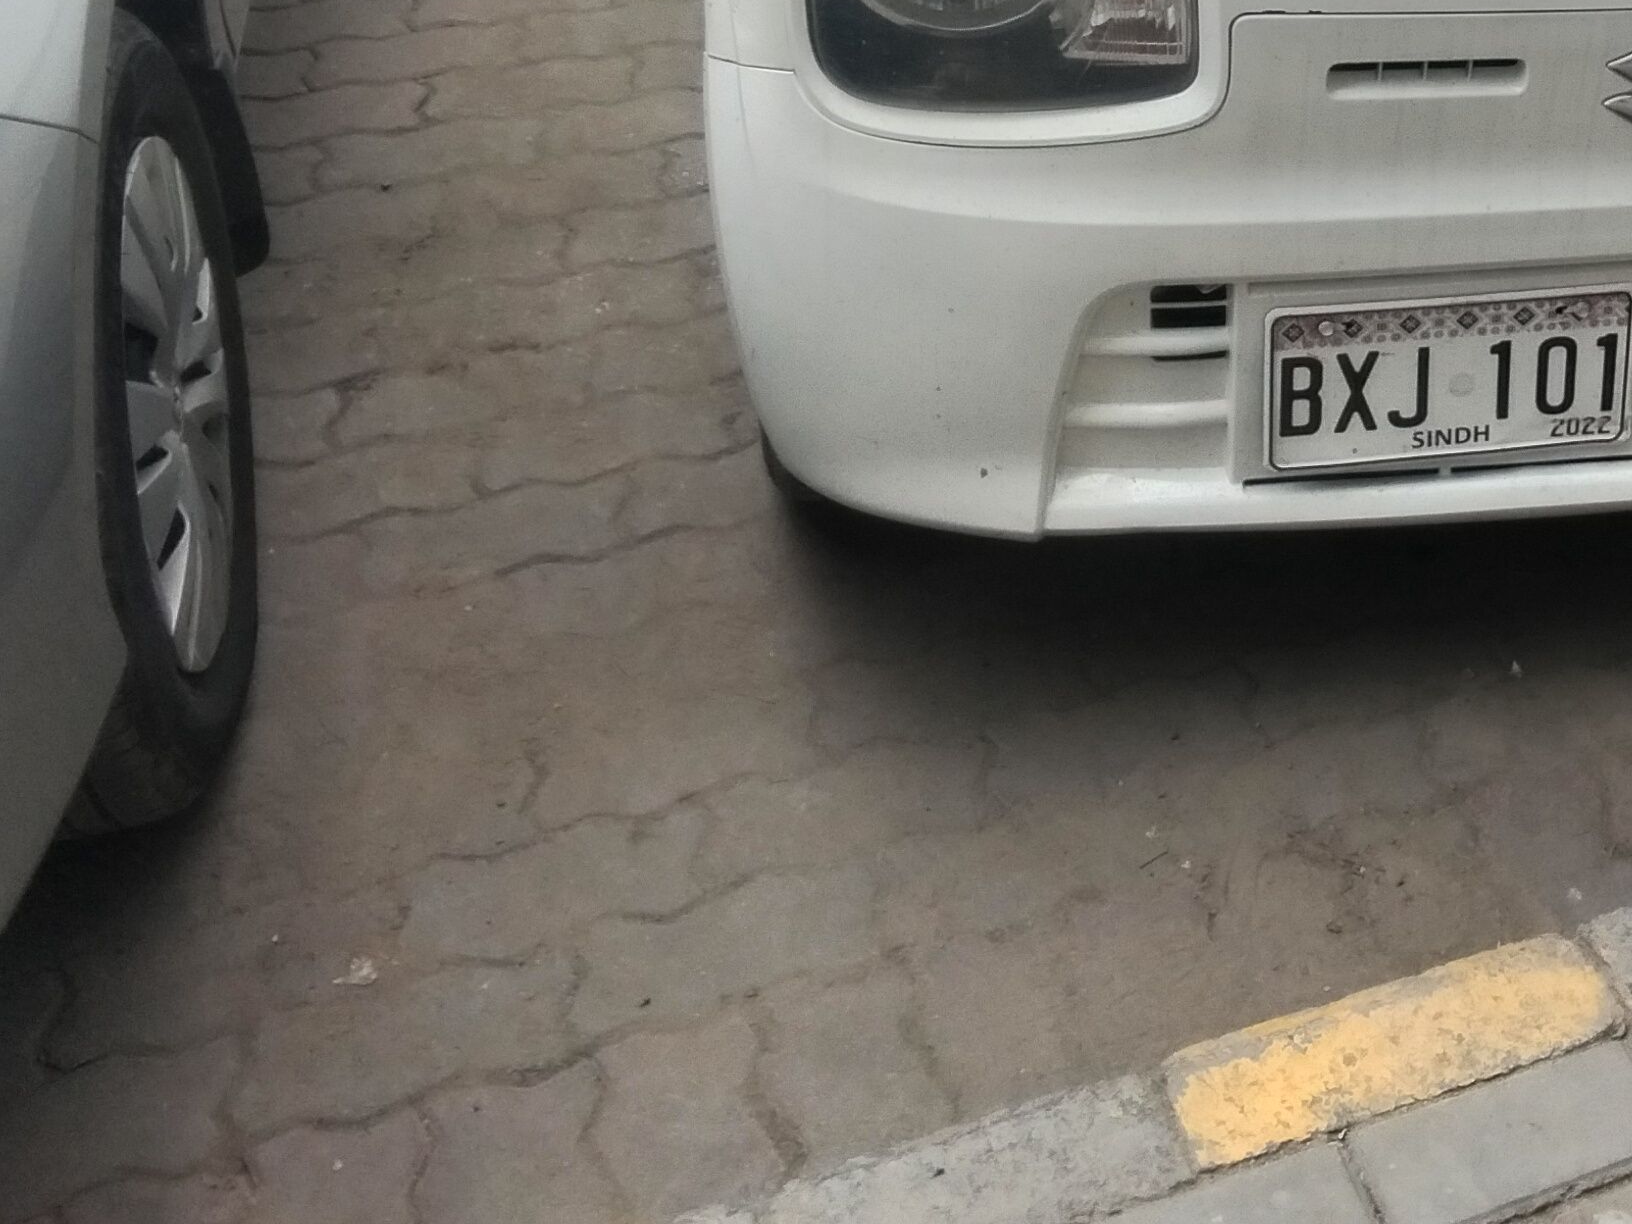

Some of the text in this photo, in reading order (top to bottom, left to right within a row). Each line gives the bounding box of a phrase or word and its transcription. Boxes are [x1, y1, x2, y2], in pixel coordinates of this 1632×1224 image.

[1278, 332, 1619, 438] BXJ 101
[1410, 415, 1612, 449] SINDH 2022
